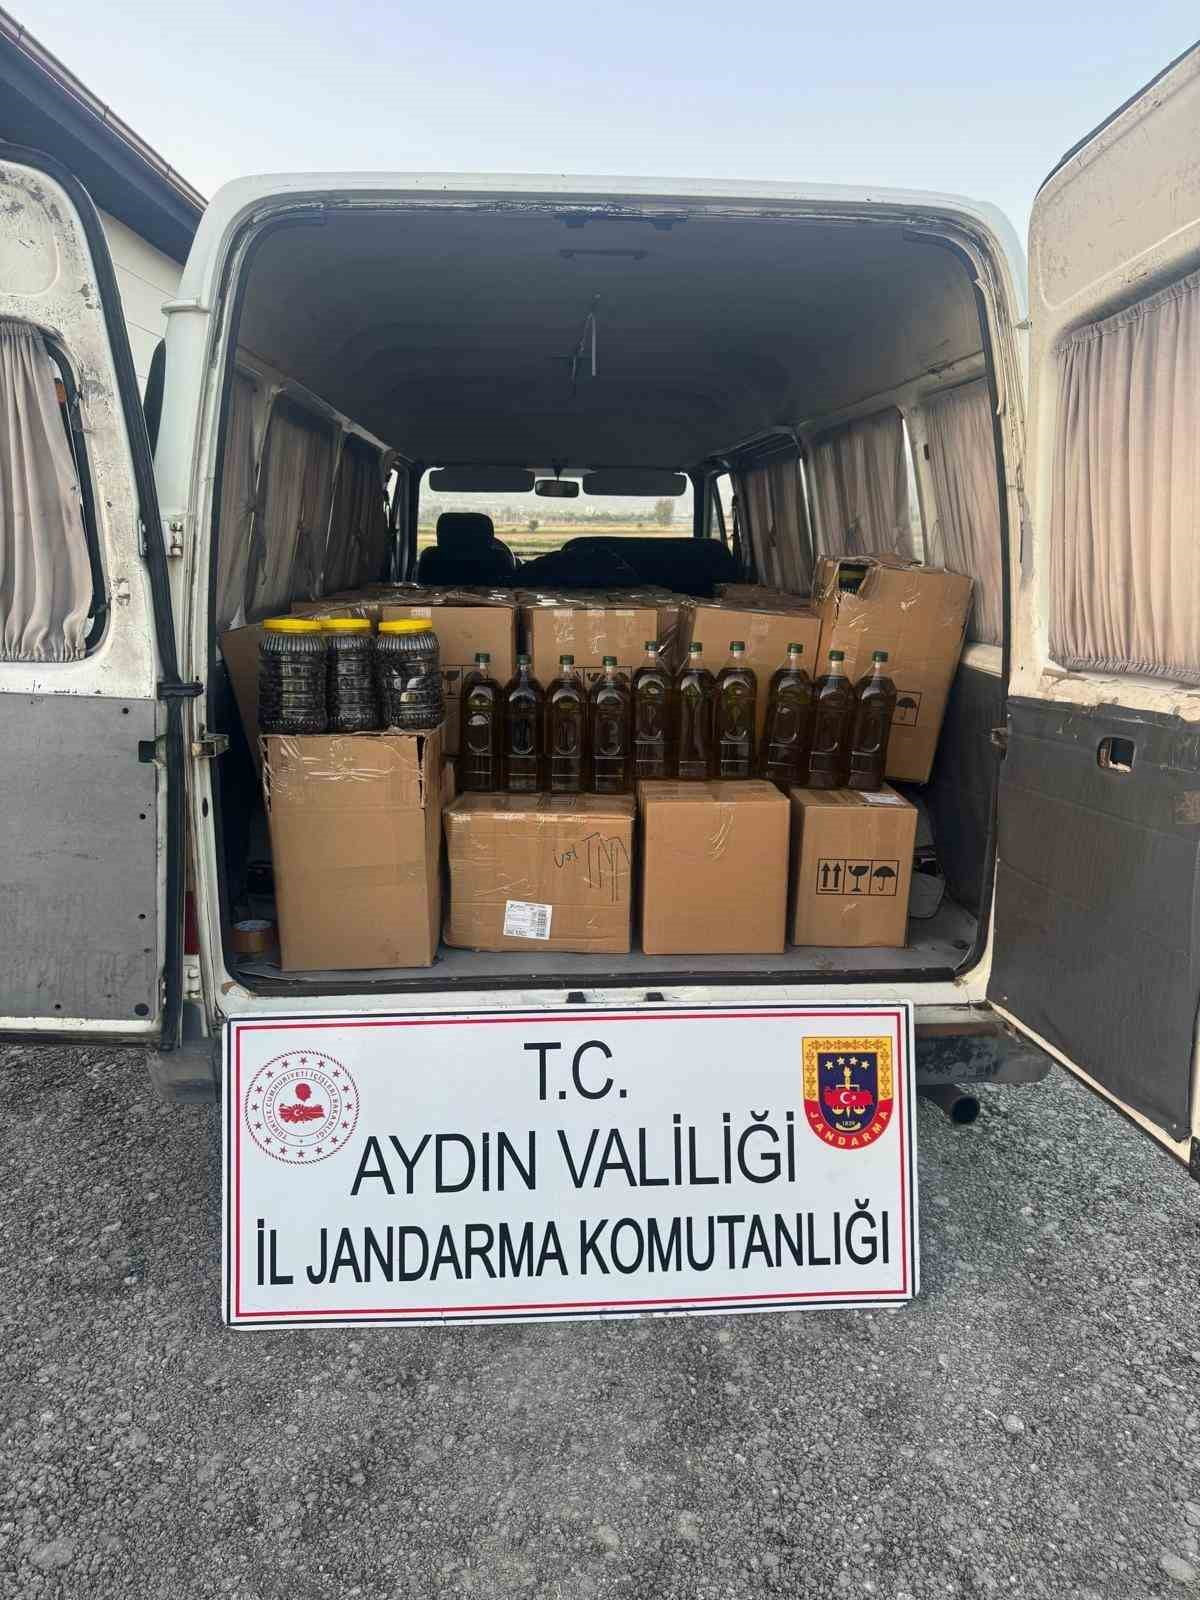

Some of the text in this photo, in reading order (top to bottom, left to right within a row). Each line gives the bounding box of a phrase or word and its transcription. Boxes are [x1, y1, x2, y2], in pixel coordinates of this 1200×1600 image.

[524, 1041, 626, 1100] T.C.
[350, 1111, 795, 1195] AYDIN VALİLİĞİ
[810, 1111, 889, 1146] JANDARMA
[257, 1199, 889, 1285] İL JANDARMA KOMUTANLIĞI
